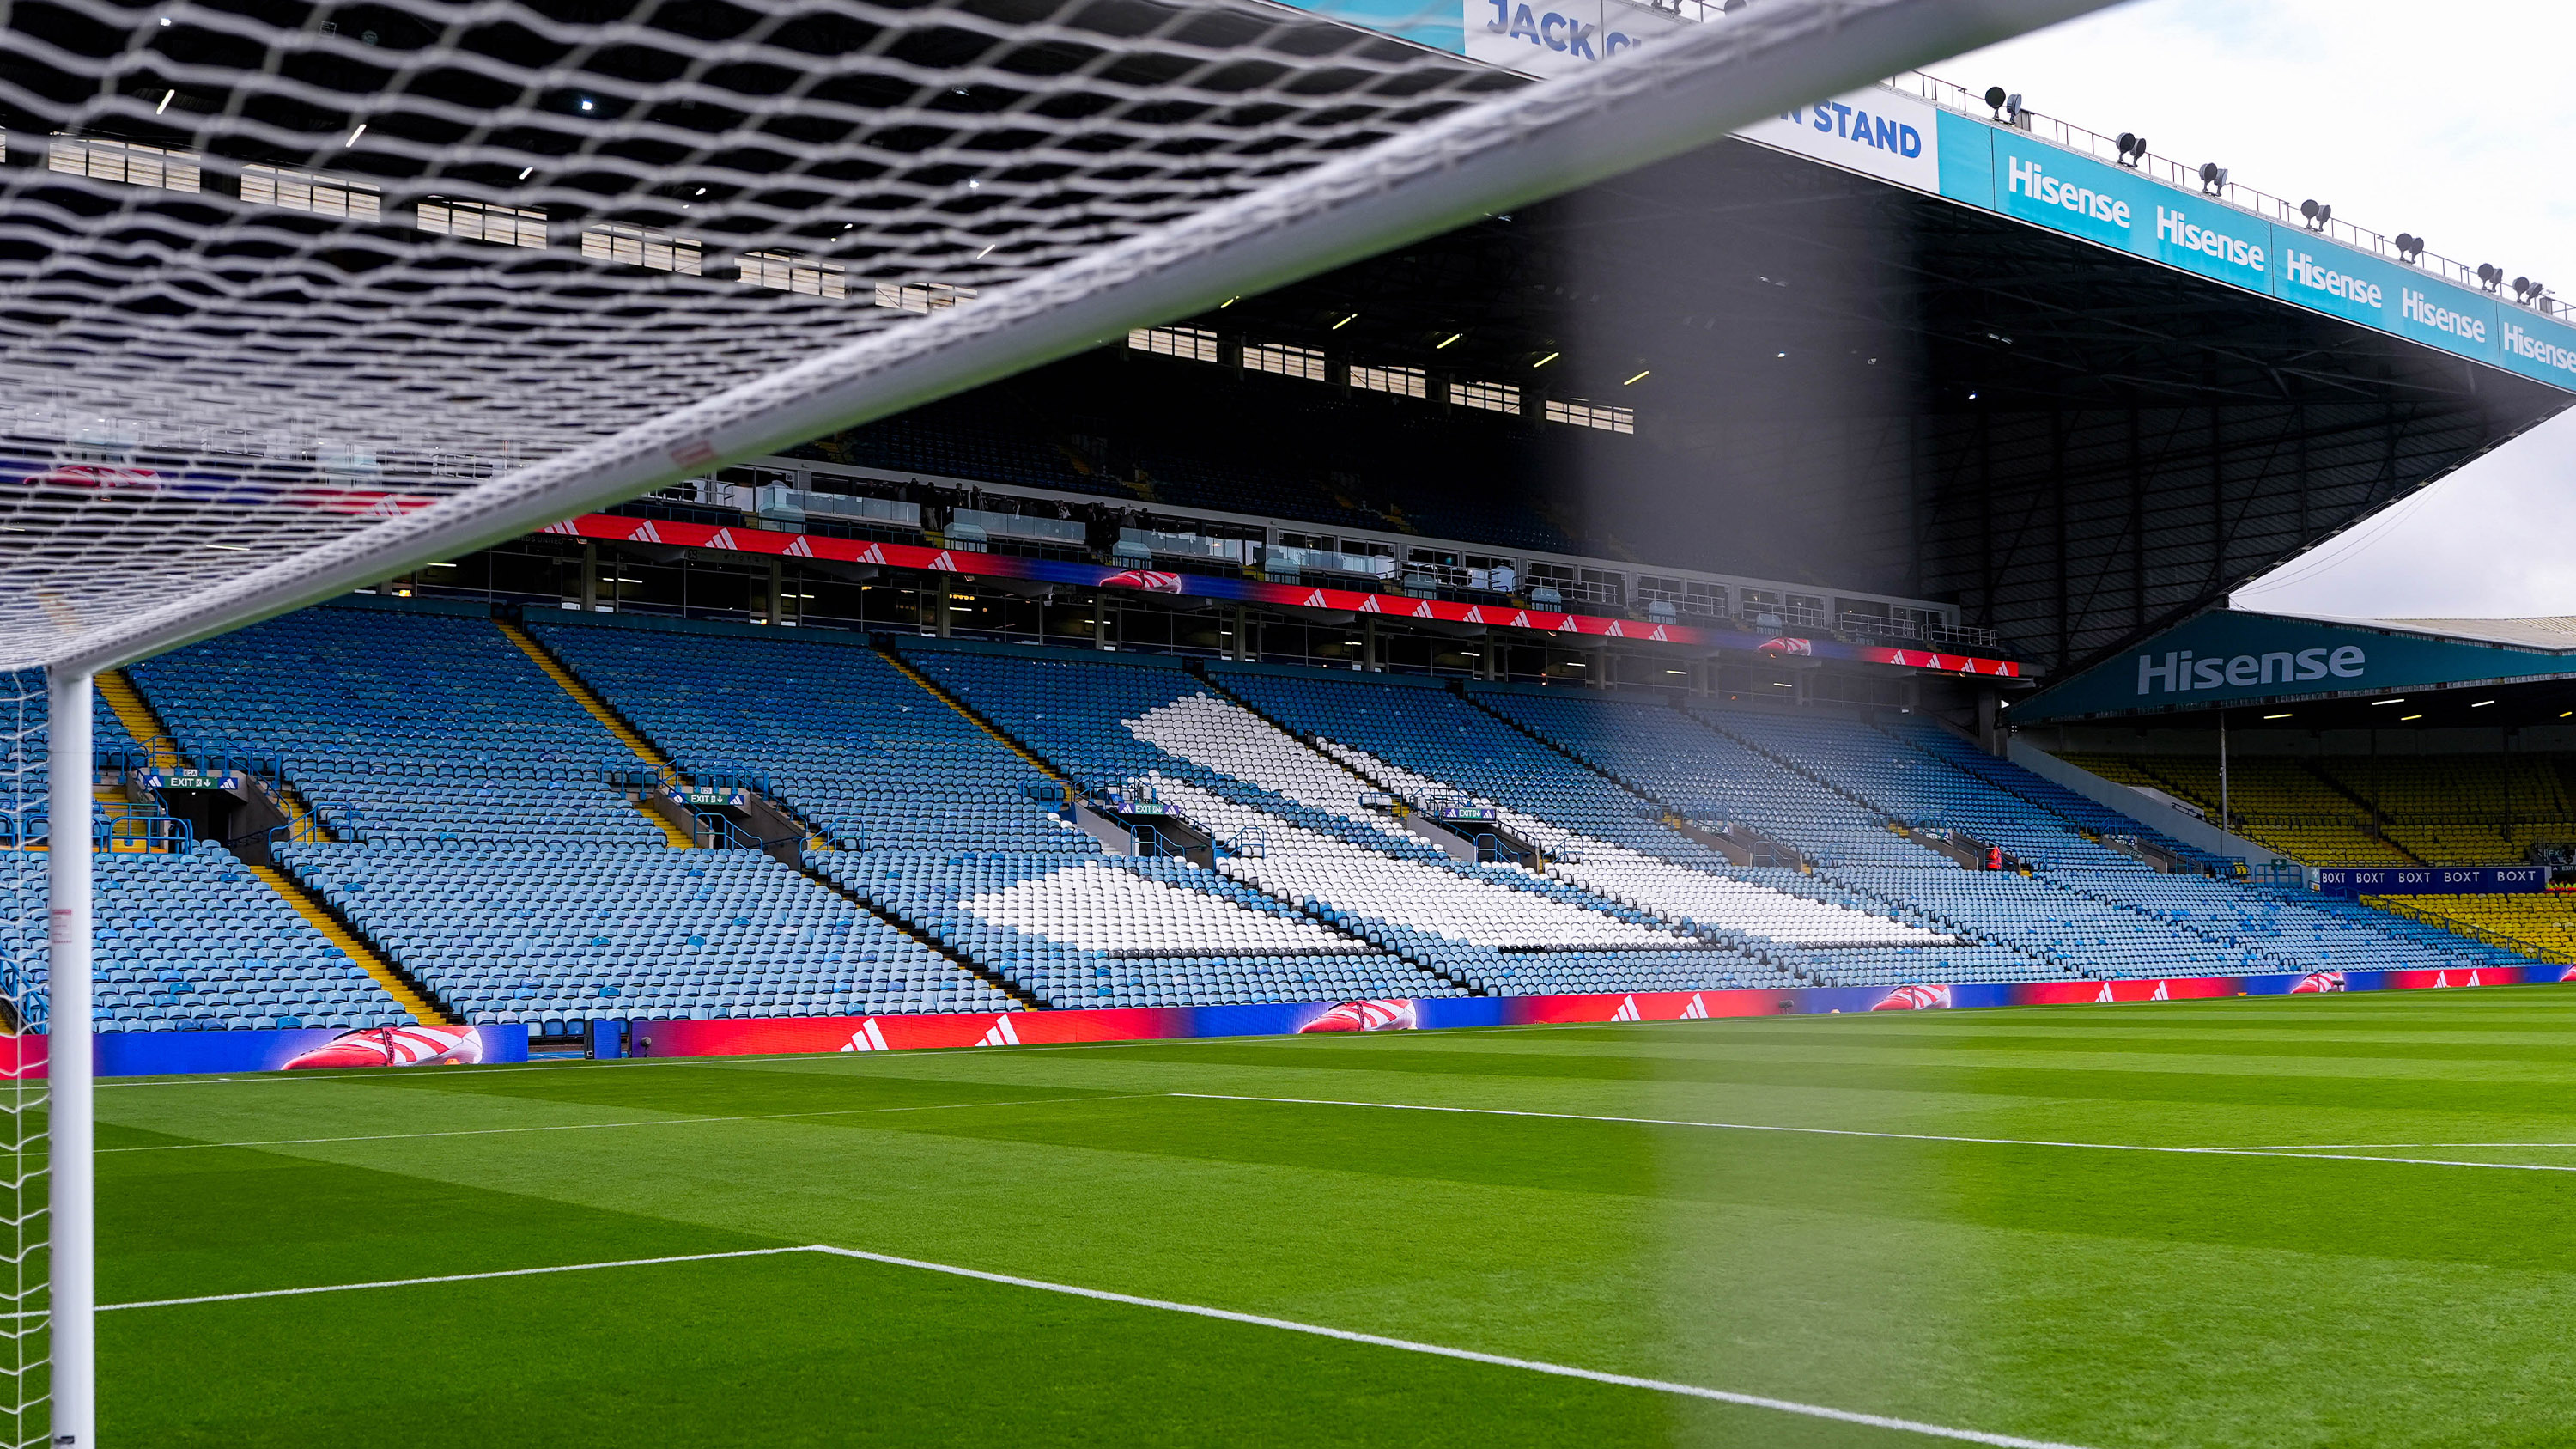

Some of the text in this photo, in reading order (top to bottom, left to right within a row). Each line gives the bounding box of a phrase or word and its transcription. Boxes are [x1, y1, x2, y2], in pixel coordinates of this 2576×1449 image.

[1486, 0, 1596, 62] JACK
[1813, 98, 1922, 159] STAND
[2008, 155, 2130, 228] Hisense
[2157, 205, 2265, 271] Hisense
[2287, 248, 2383, 309] Hisense
[2402, 286, 2486, 344] Hisense
[2504, 321, 2576, 373] Hisense
[2137, 645, 2366, 696] Hisense
[171, 778, 194, 787] EXIT
[1135, 804, 1151, 813] EXIT
[2322, 870, 2537, 884] BOXT BOXT BOXT BOXT BOXT
